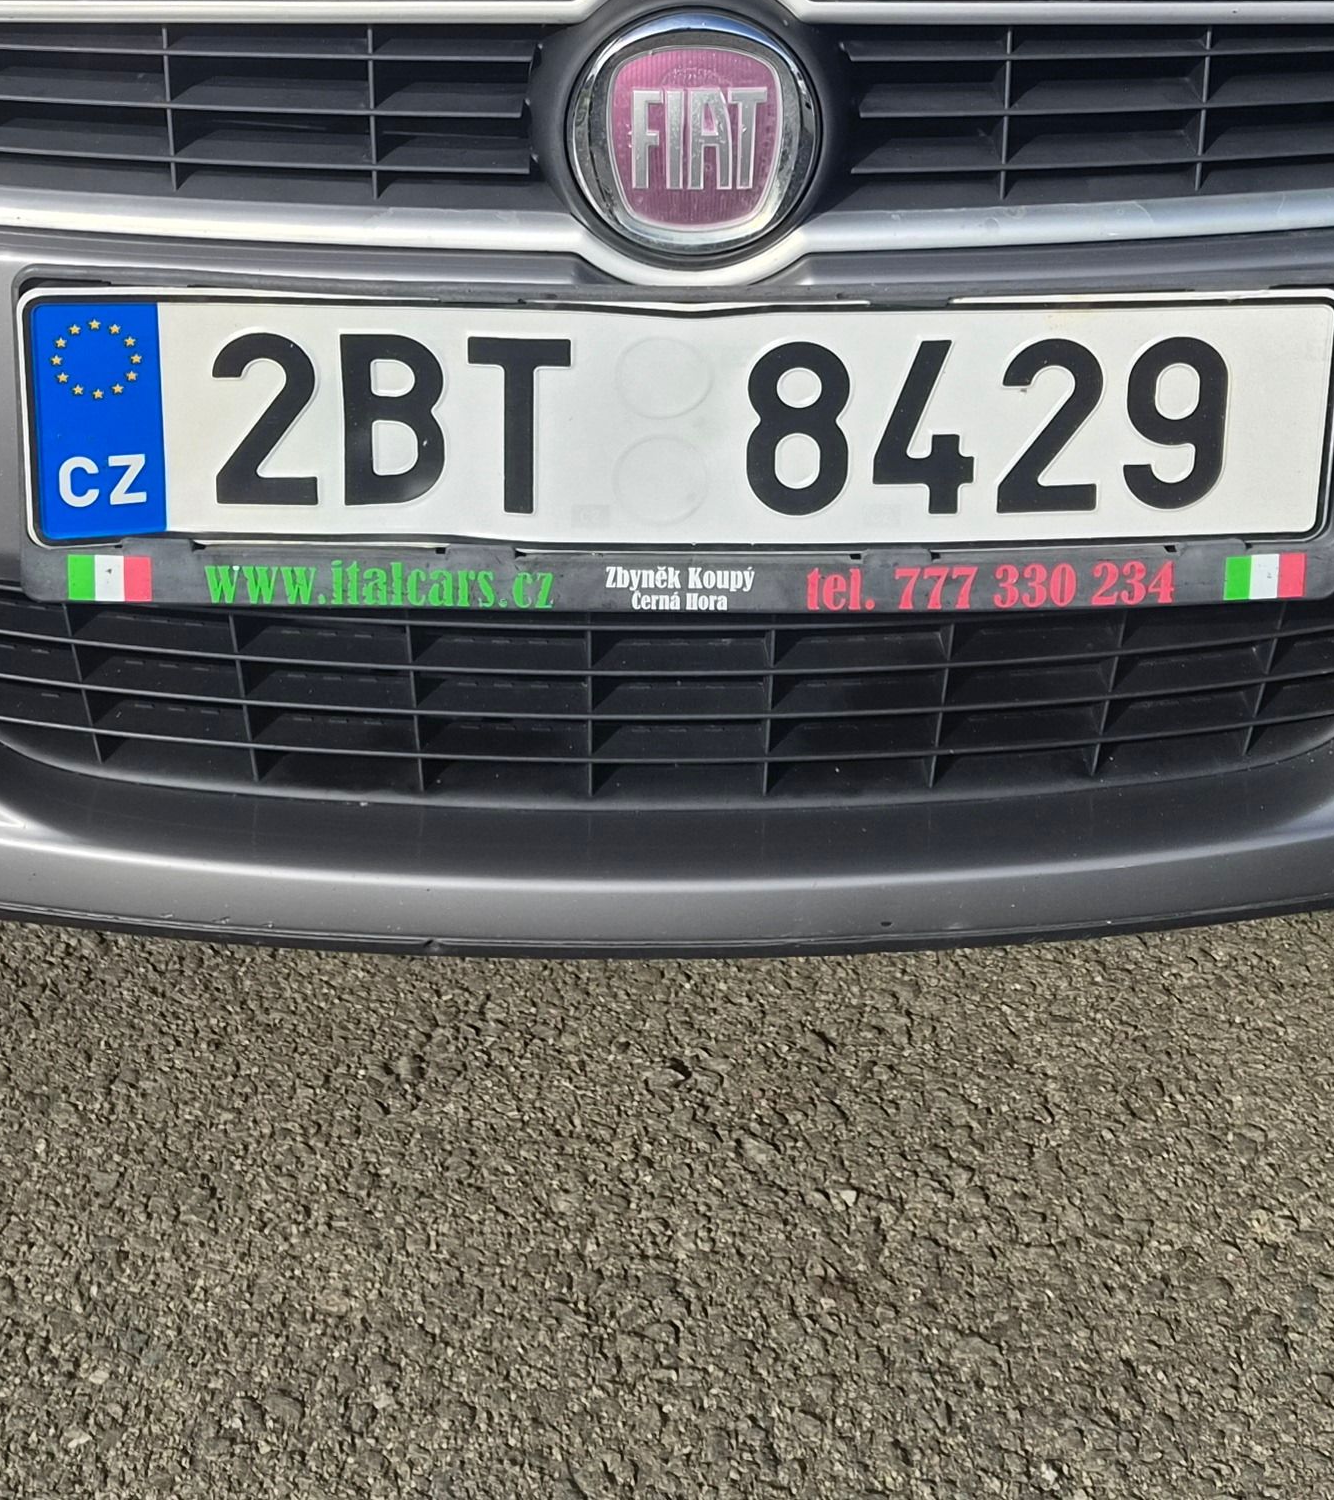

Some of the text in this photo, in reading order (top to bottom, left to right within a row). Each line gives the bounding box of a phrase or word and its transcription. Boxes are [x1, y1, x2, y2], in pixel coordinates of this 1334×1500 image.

[631, 86, 768, 190] FIAT
[212, 332, 1229, 516] 2BT 8429
[58, 453, 147, 508] CZ
[204, 560, 555, 611] www.italcars.cz
[605, 566, 755, 592] Zbyněk Koupý
[631, 591, 728, 611] Černá Hora
[806, 560, 1176, 612] tel. 777 330 234
